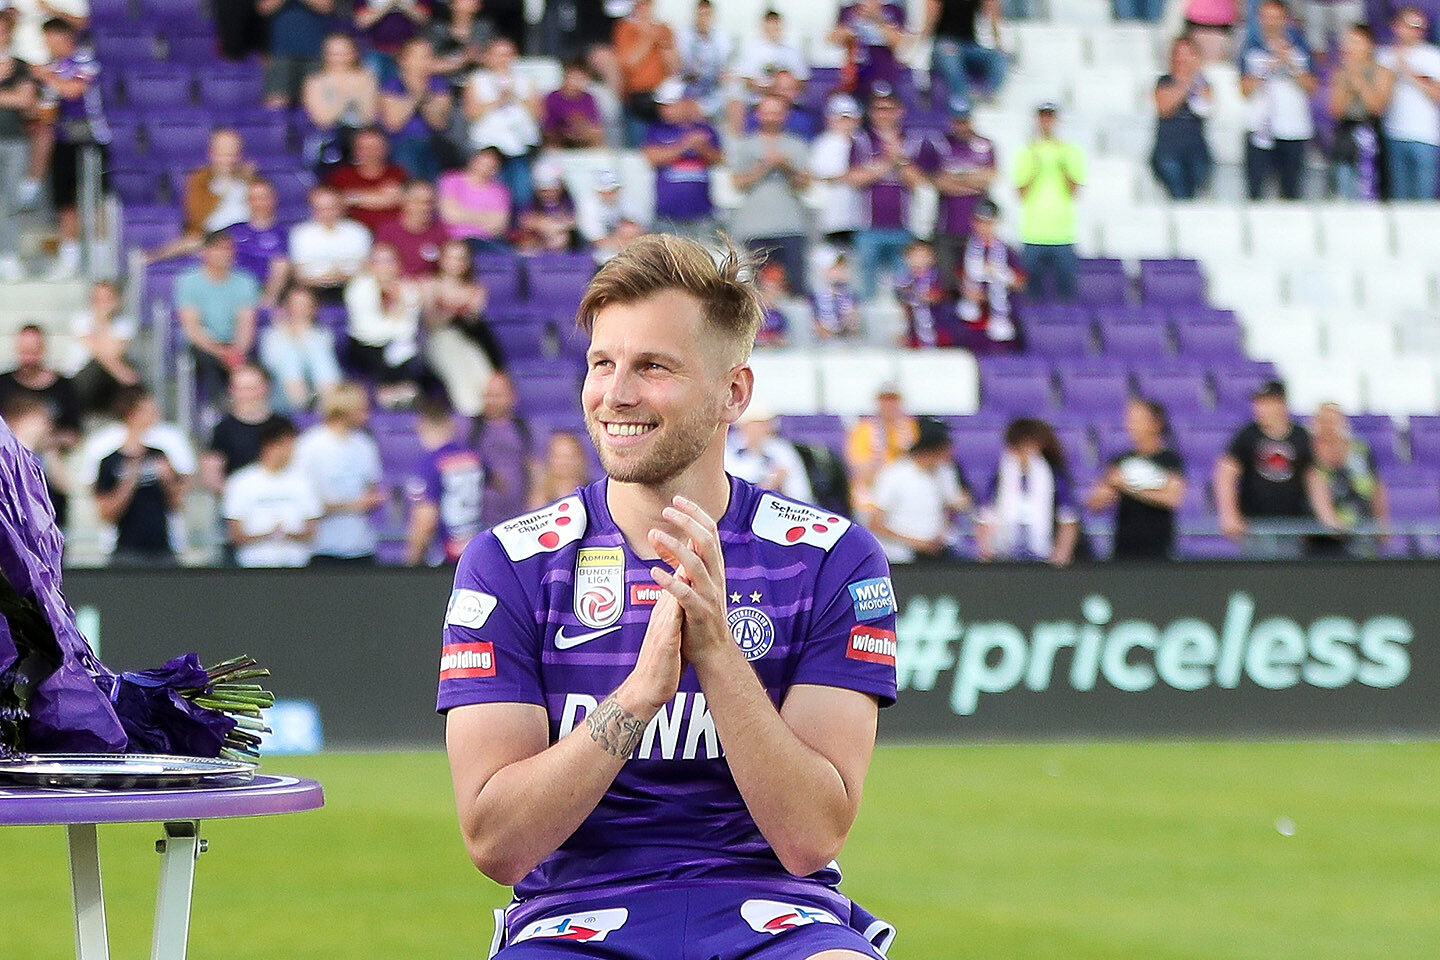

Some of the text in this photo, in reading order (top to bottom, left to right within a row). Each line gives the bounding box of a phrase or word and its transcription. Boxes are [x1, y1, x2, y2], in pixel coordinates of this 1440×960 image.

[579, 568, 620, 576] BUNDES
[856, 582, 889, 601] MVC
[859, 598, 893, 612] MOTORS
[896, 593, 1414, 716] #priceless
